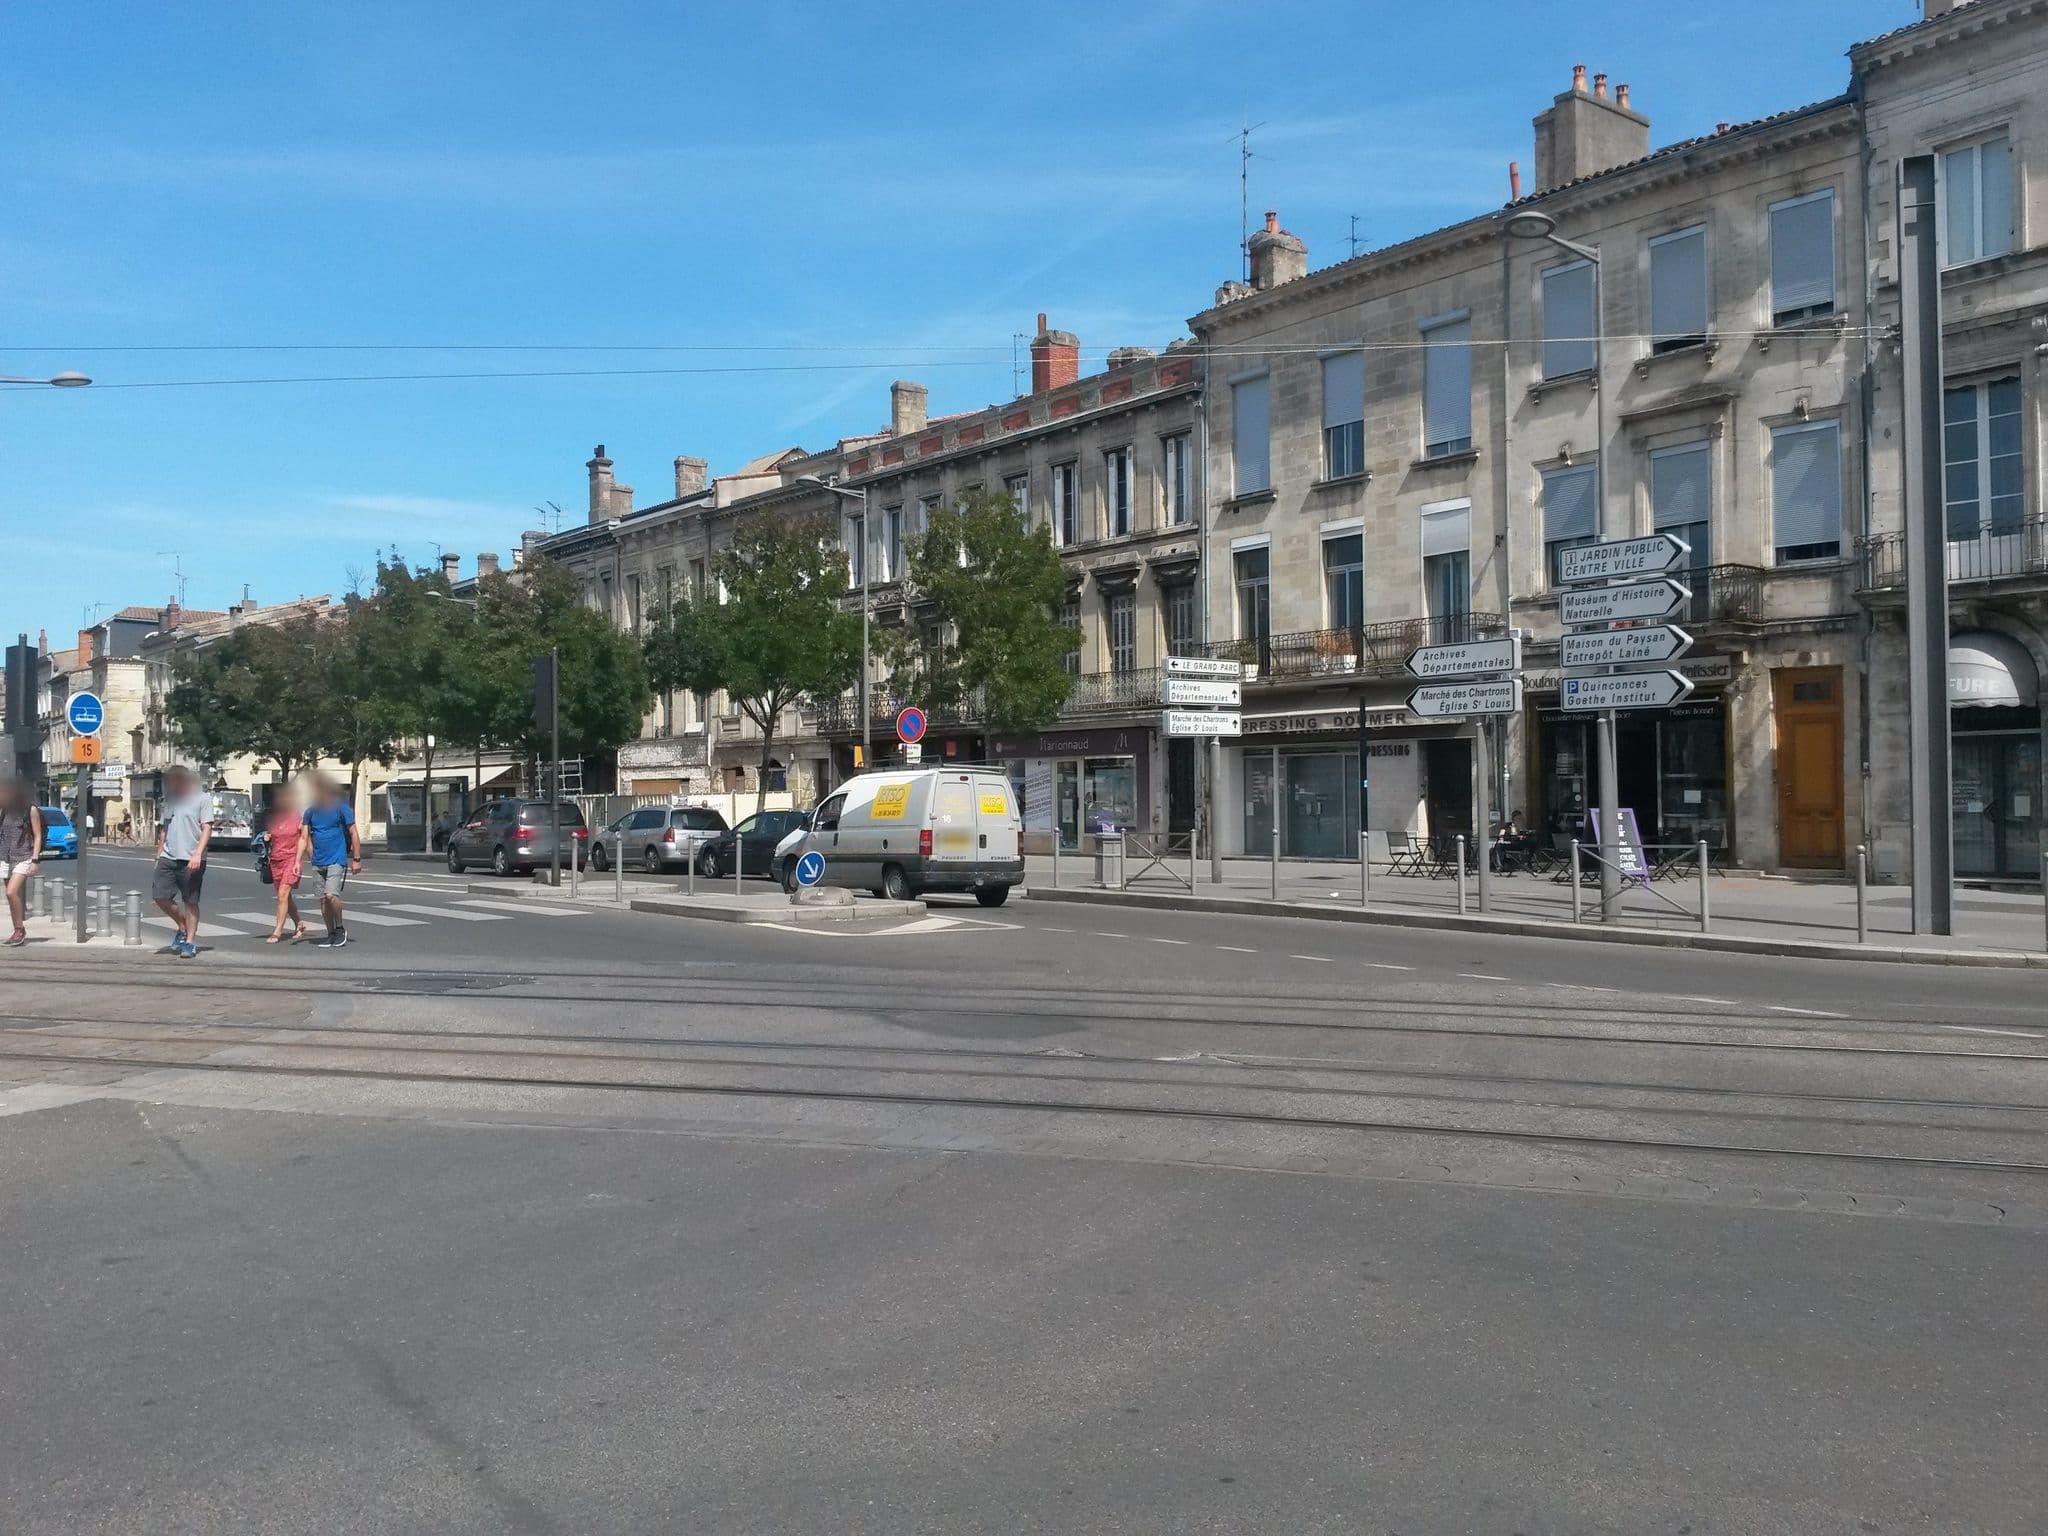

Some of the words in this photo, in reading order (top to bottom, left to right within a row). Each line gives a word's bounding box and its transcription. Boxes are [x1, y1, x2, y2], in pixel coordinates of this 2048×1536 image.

[1580, 547, 1620, 562] JARDIN
[1624, 541, 1664, 556] PUBLIC
[1565, 562, 1608, 577] CENTRE
[1614, 557, 1645, 570] VILLE
[1565, 593, 1607, 607] Muséum
[1612, 588, 1665, 602] d'Histoire
[1565, 606, 1612, 620] Naturelle
[1566, 638, 1603, 650] Maison
[1608, 635, 1621, 647] du
[1626, 633, 1665, 646] Paysan
[1423, 650, 1466, 661] Archives
[1566, 649, 1613, 666] Entrepôt
[1182, 661, 1191, 669] LE
[1193, 662, 1218, 671] GRAND
[1220, 663, 1238, 672] PARC
[1422, 658, 1510, 674] Départementales
[1171, 683, 1201, 691] Archives
[1581, 680, 1648, 692] Quinconces
[1420, 689, 1451, 701] Marché
[1452, 688, 1467, 698] des
[1468, 687, 1511, 698] Chartrons
[1567, 694, 1606, 706] Goethe
[1611, 692, 1657, 703] Institut
[1440, 699, 1468, 713] Église
[1485, 699, 1511, 709] Louis
[1242, 718, 1318, 732] PRESSING
[81, 743, 93, 757] 15
[1369, 744, 1410, 757] RESSING
